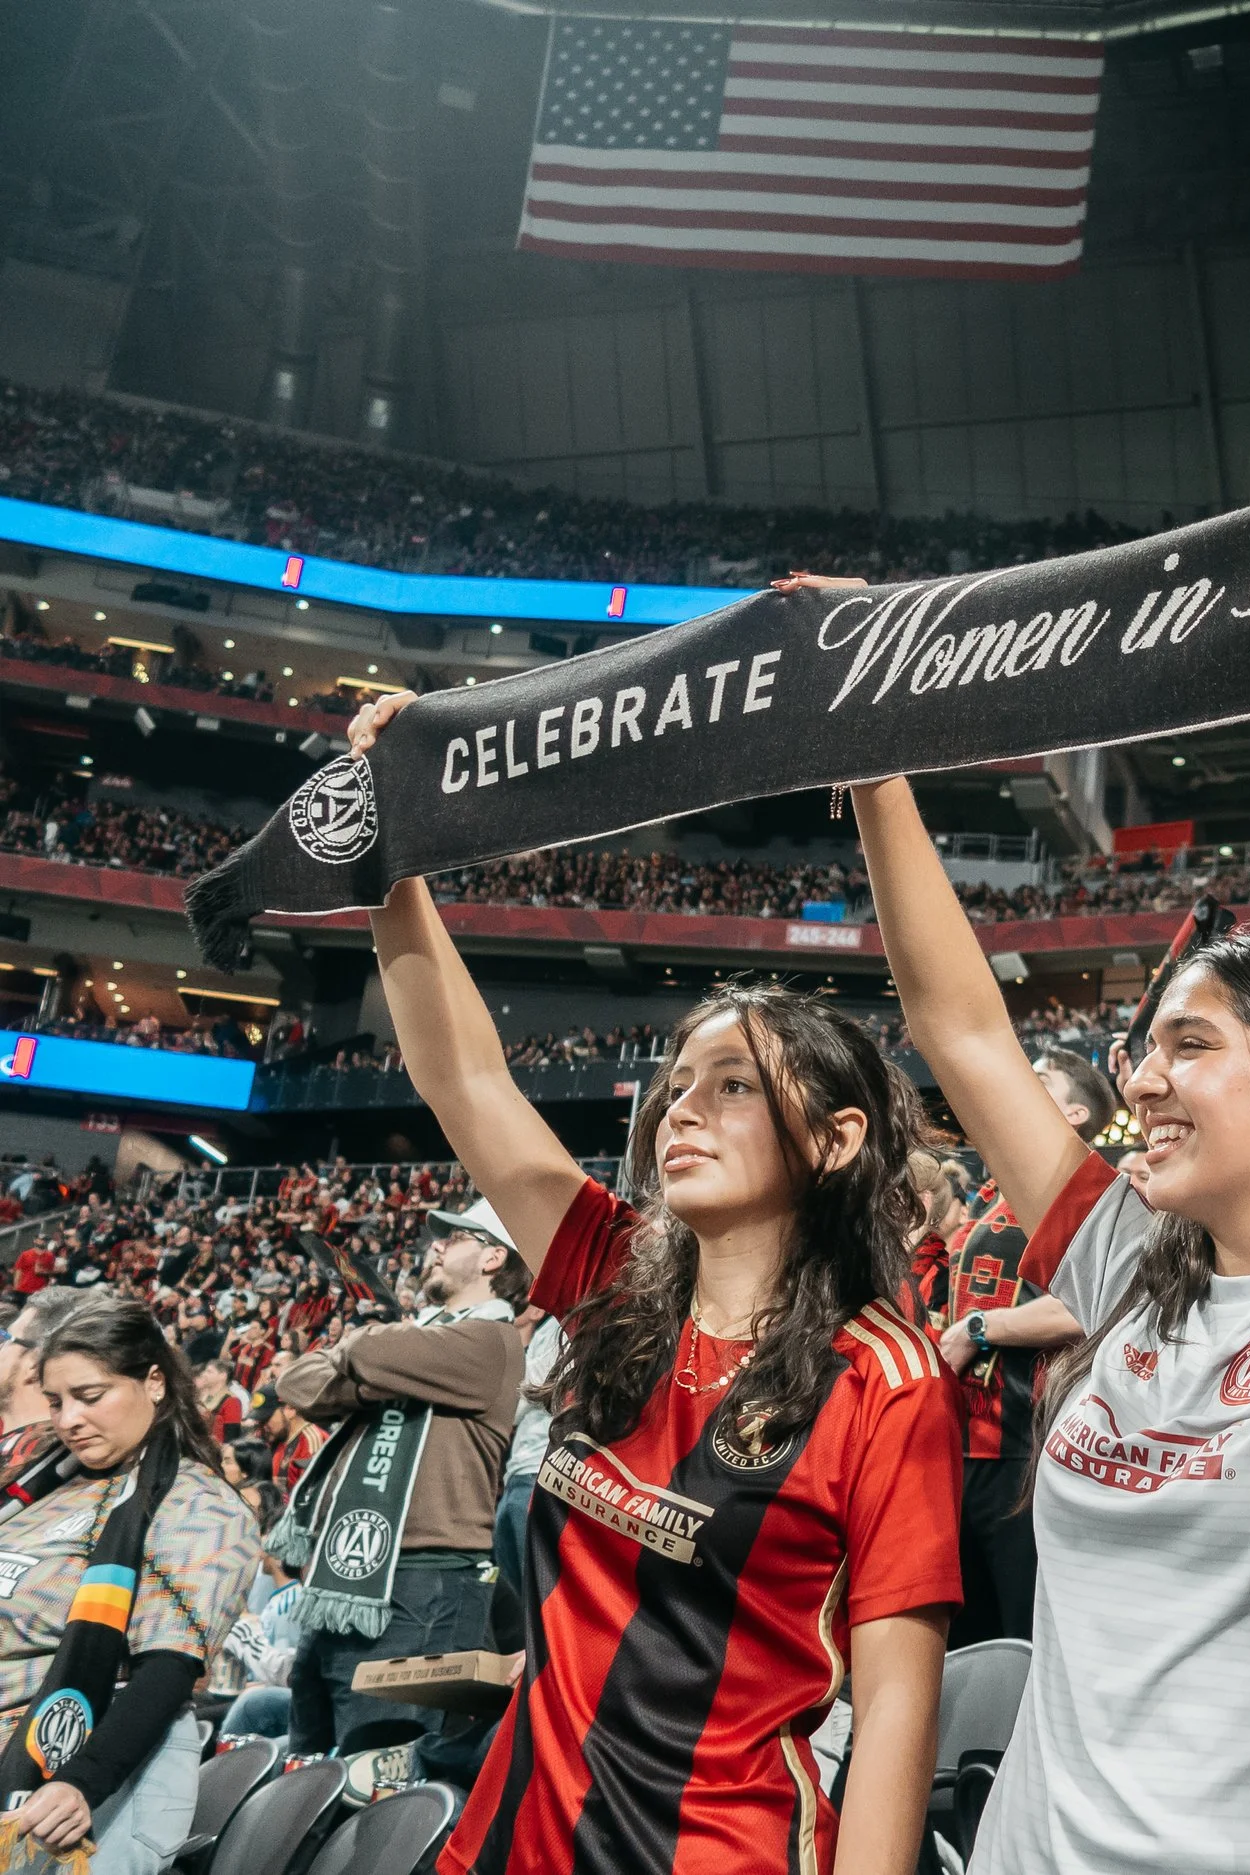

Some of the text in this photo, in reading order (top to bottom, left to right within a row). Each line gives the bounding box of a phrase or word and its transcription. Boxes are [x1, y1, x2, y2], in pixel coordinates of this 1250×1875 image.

[441, 650, 782, 794] CELEBRATE
[818, 566, 1111, 712] Women
[1121, 553, 1225, 655] in
[716, 1438, 770, 1467] UNITED FC
[1050, 1437, 1208, 1490] INSURAE
[1061, 1412, 1233, 1473] AMERICAN FALY
[545, 1472, 677, 1553] INSURANCE
[547, 1446, 705, 1539] AMERICAN FAMILY
[342, 1512, 387, 1531] ATLANTA
[329, 1554, 363, 1577] UNITED
